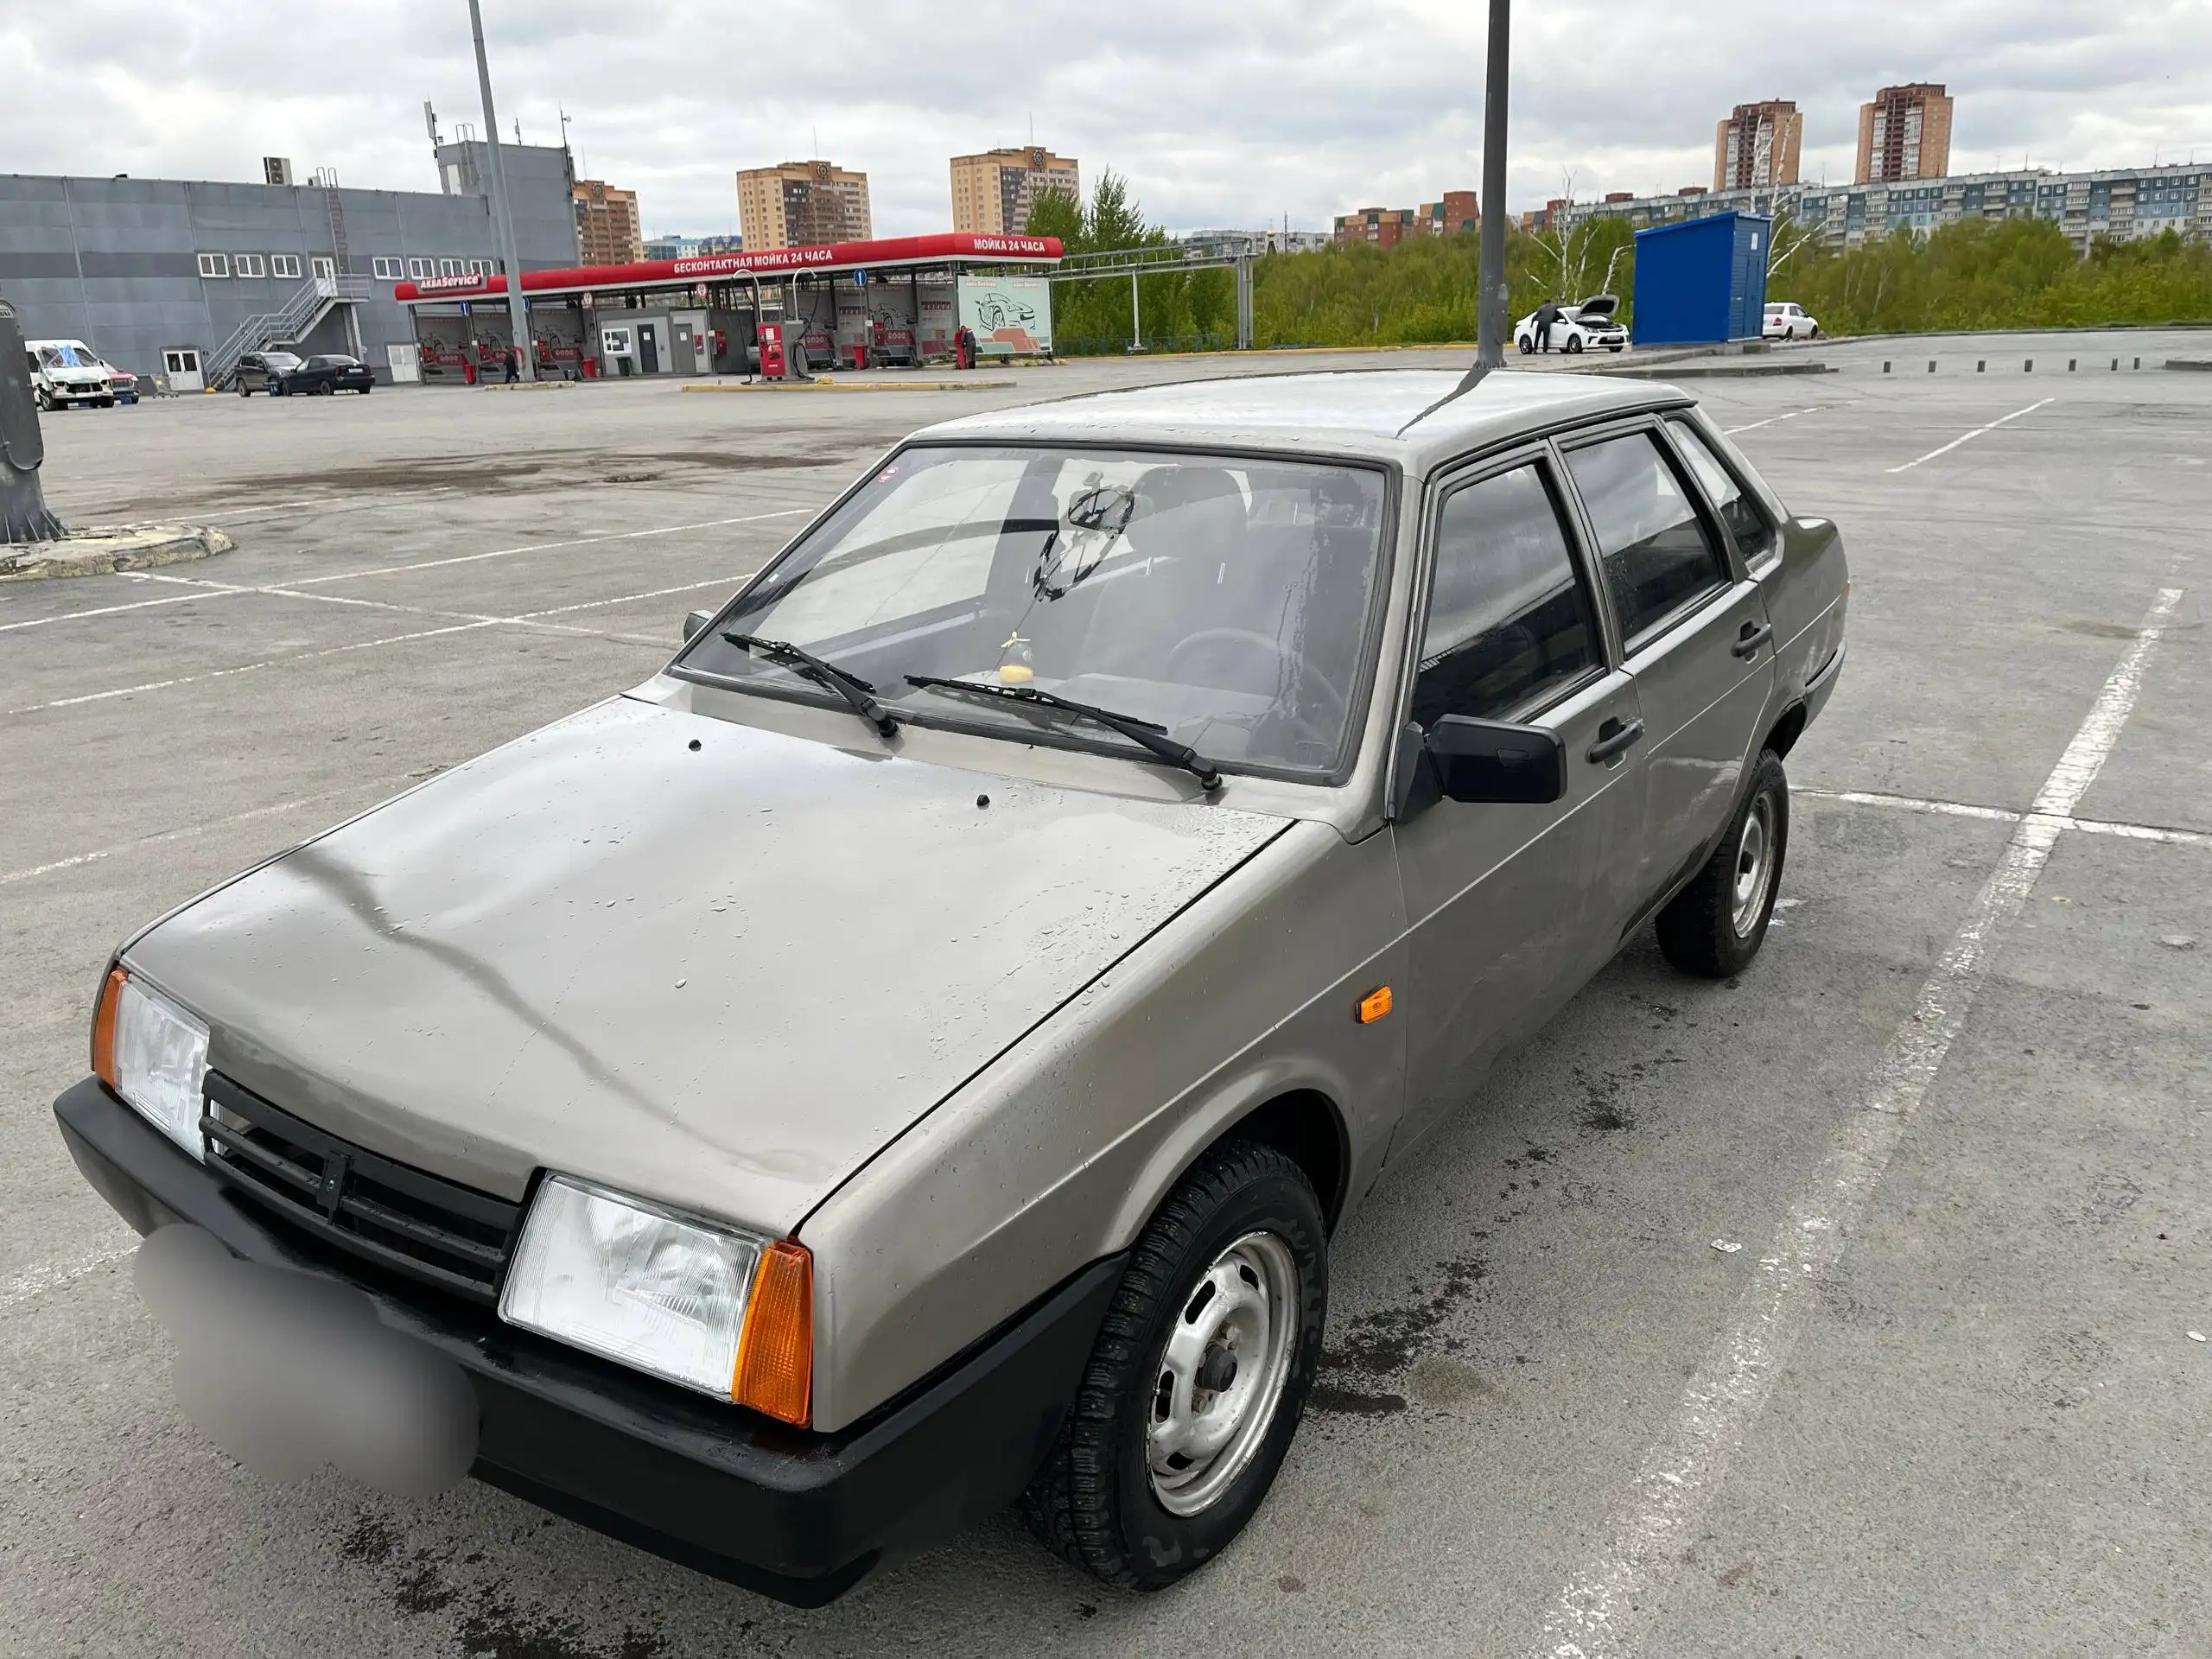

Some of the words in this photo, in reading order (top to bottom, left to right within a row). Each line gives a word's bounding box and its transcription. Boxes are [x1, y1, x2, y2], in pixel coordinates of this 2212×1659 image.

[974, 238, 1007, 251] МОЙКА
[1008, 240, 1020, 251] 24
[1020, 241, 1045, 251] ЧАСА
[674, 257, 752, 273] БЕСКОНТАКТНАЯ
[754, 253, 789, 267] МОЙКА
[791, 252, 803, 264] 24
[804, 249, 833, 262] ЧАСА
